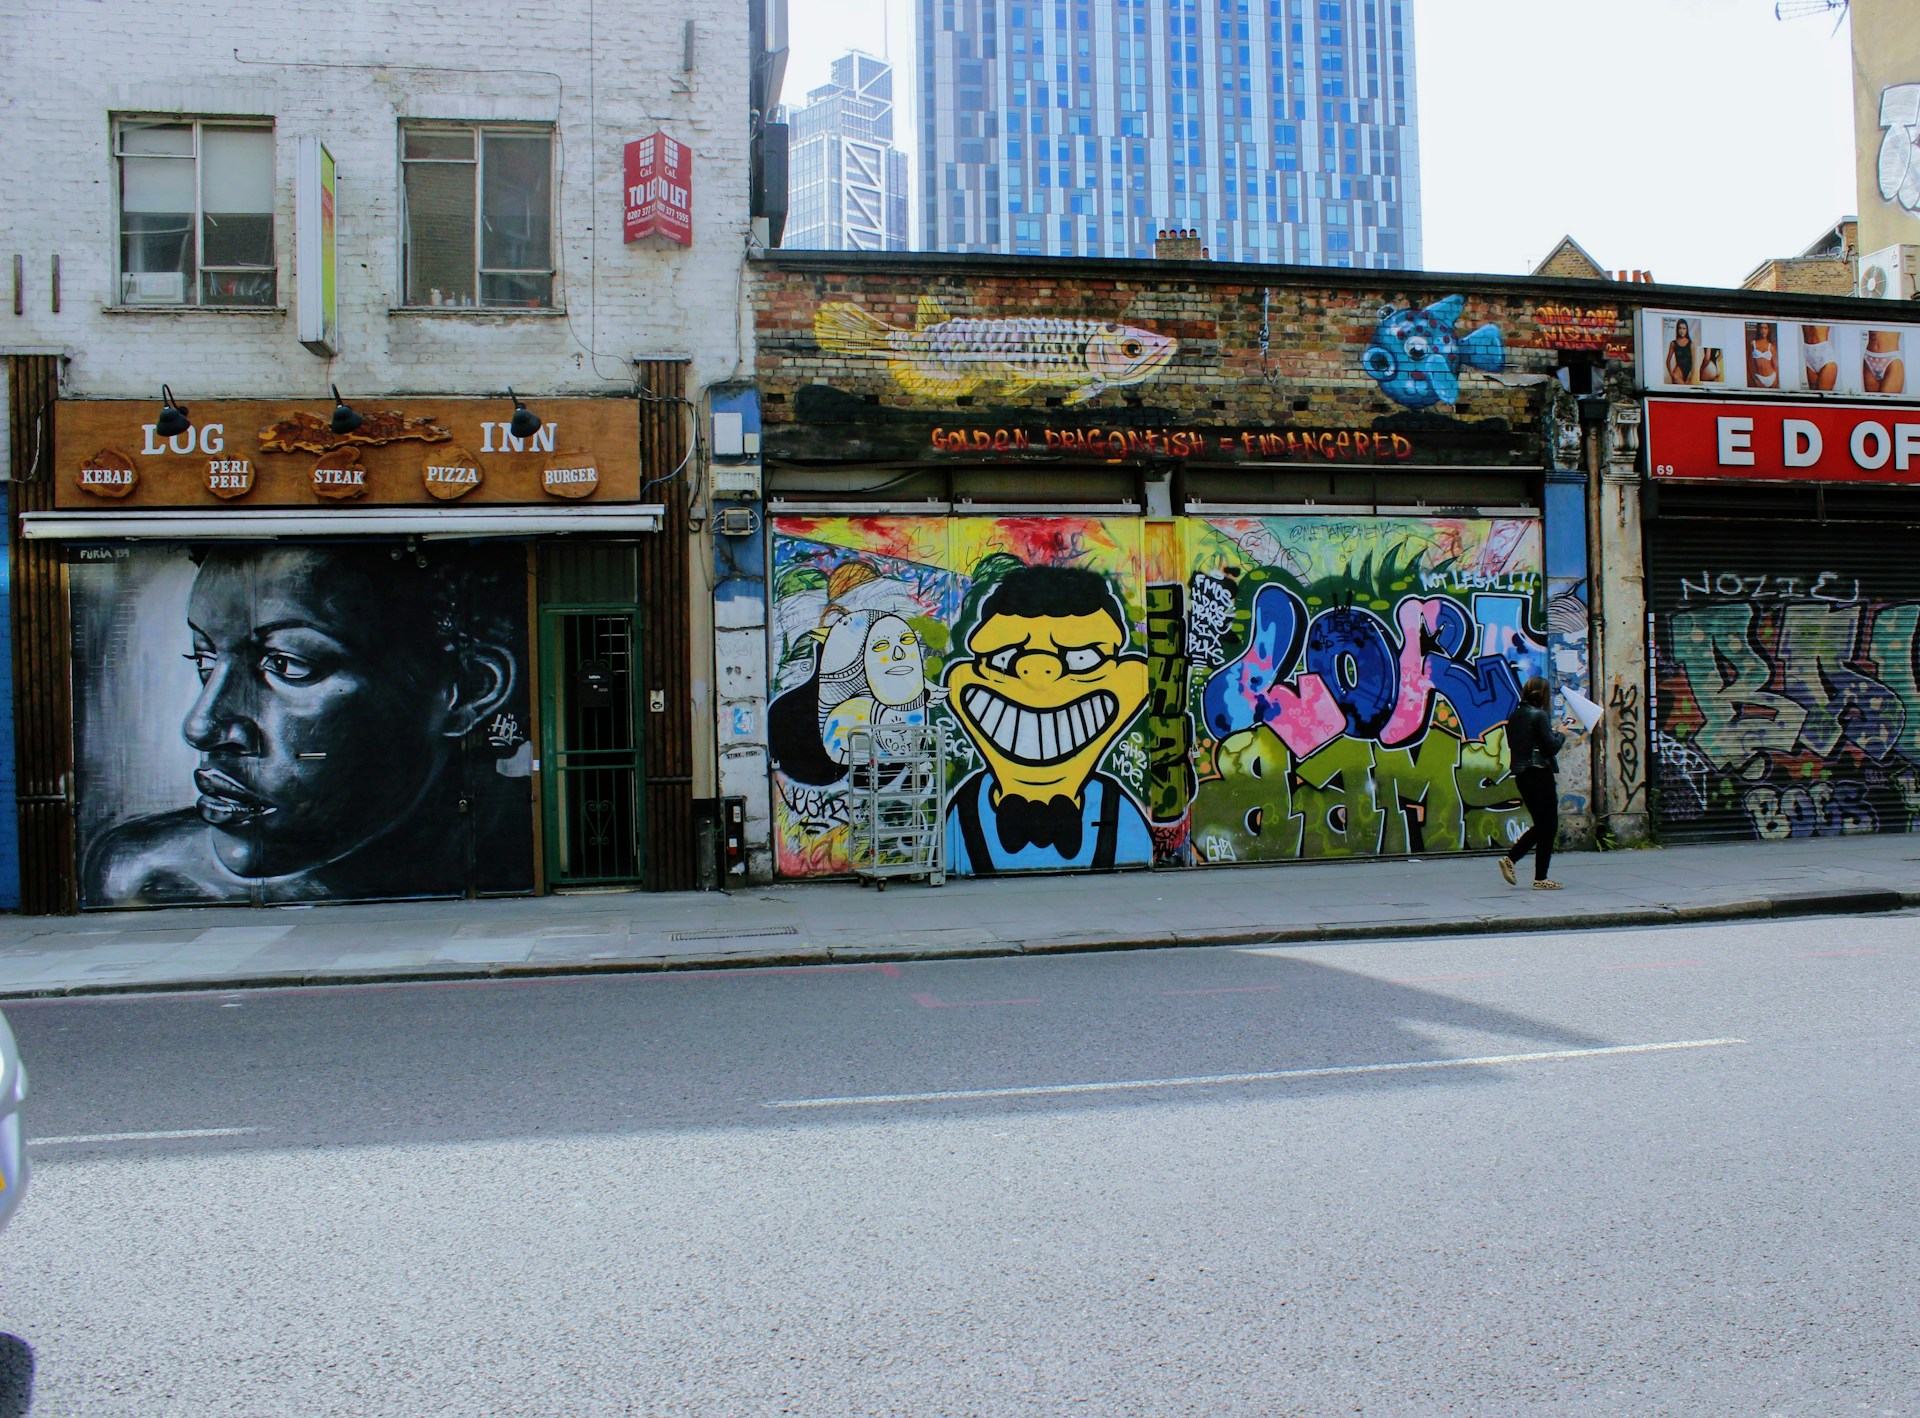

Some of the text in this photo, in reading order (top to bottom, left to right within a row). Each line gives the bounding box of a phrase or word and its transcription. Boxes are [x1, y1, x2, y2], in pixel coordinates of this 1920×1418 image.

[629, 183, 645, 207] TO
[670, 183, 687, 209] LET
[141, 422, 557, 454] LOG INN
[209, 460, 248, 474] PERI
[427, 466, 479, 483] PIZZA
[1656, 464, 1674, 476] 69
[82, 469, 133, 484] KEBAB
[209, 475, 248, 489] PERI
[314, 469, 364, 485] STEAK
[544, 468, 597, 484] BURGER
[1420, 571, 1448, 592] NOT
